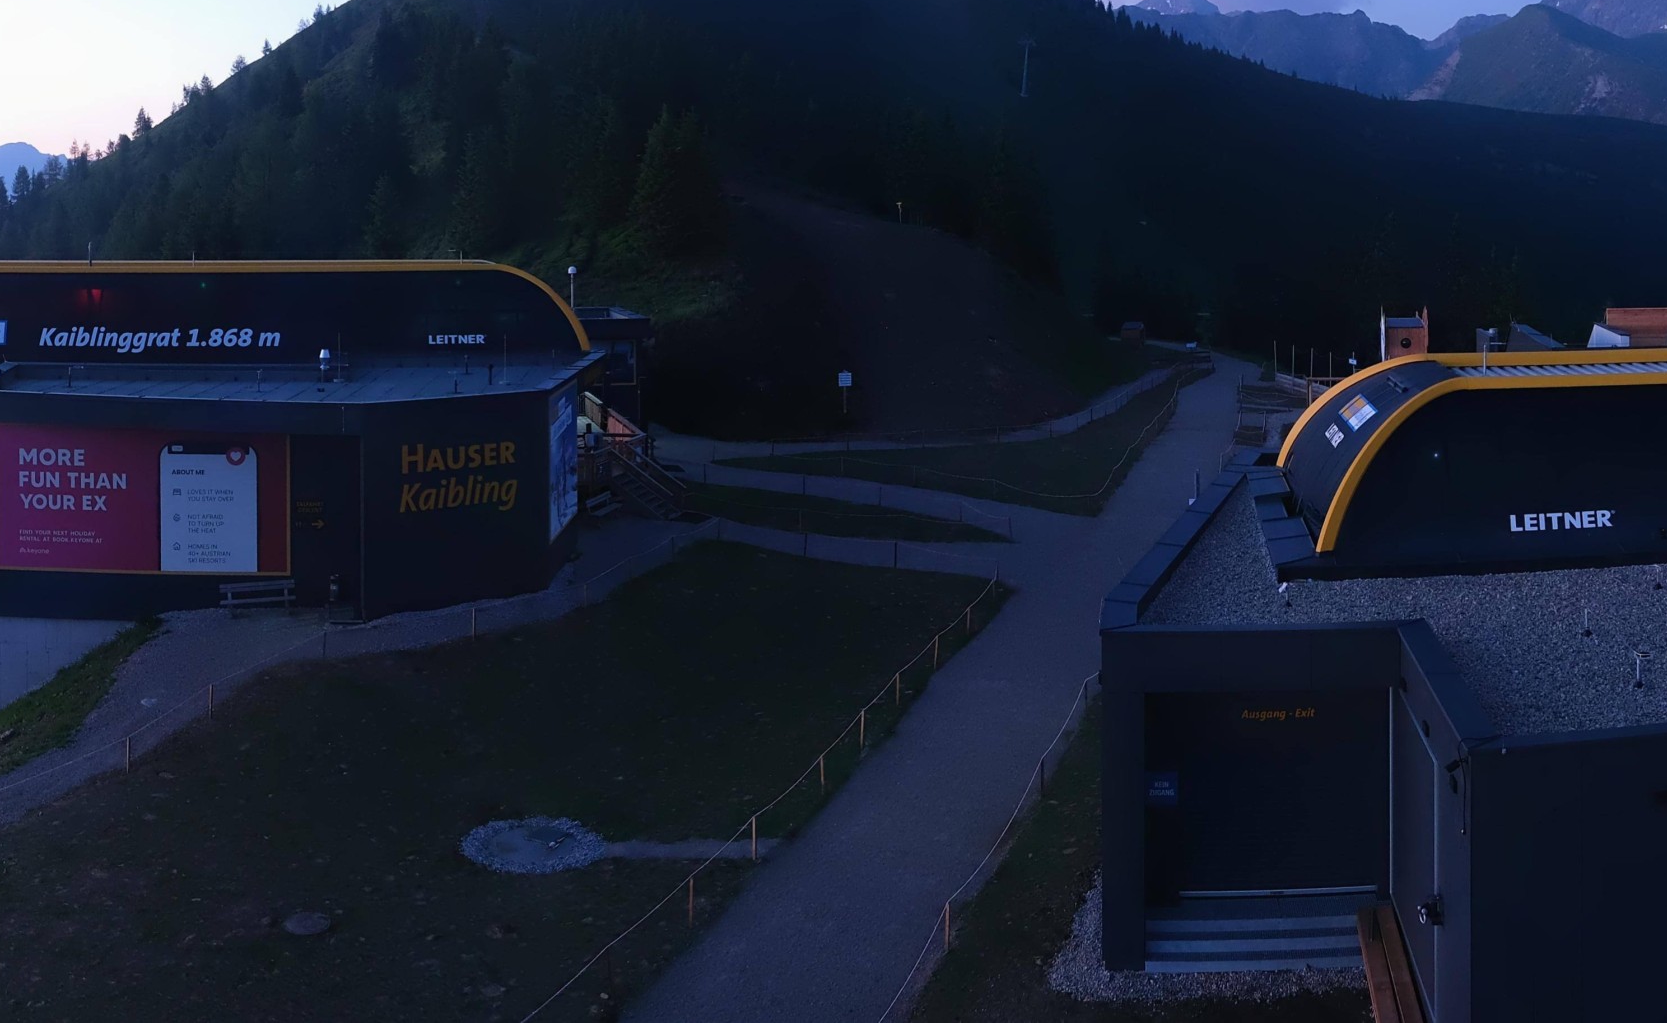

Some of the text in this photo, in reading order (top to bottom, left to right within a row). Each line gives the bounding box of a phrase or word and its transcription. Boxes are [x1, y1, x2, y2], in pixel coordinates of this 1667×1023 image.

[38, 326, 281, 353] Kaiblinggrat 1.868 m
[428, 333, 486, 345] LEITNER
[18, 448, 86, 466] MORE
[401, 441, 517, 475] HAUSER
[18, 471, 127, 489] FUN THAN
[20, 493, 107, 511] YOUR EX
[400, 475, 519, 513] Kaibling
[1509, 510, 1614, 532] LEITNER
[1241, 709, 1287, 721] Ausgang
[1295, 707, 1316, 718] Exit
